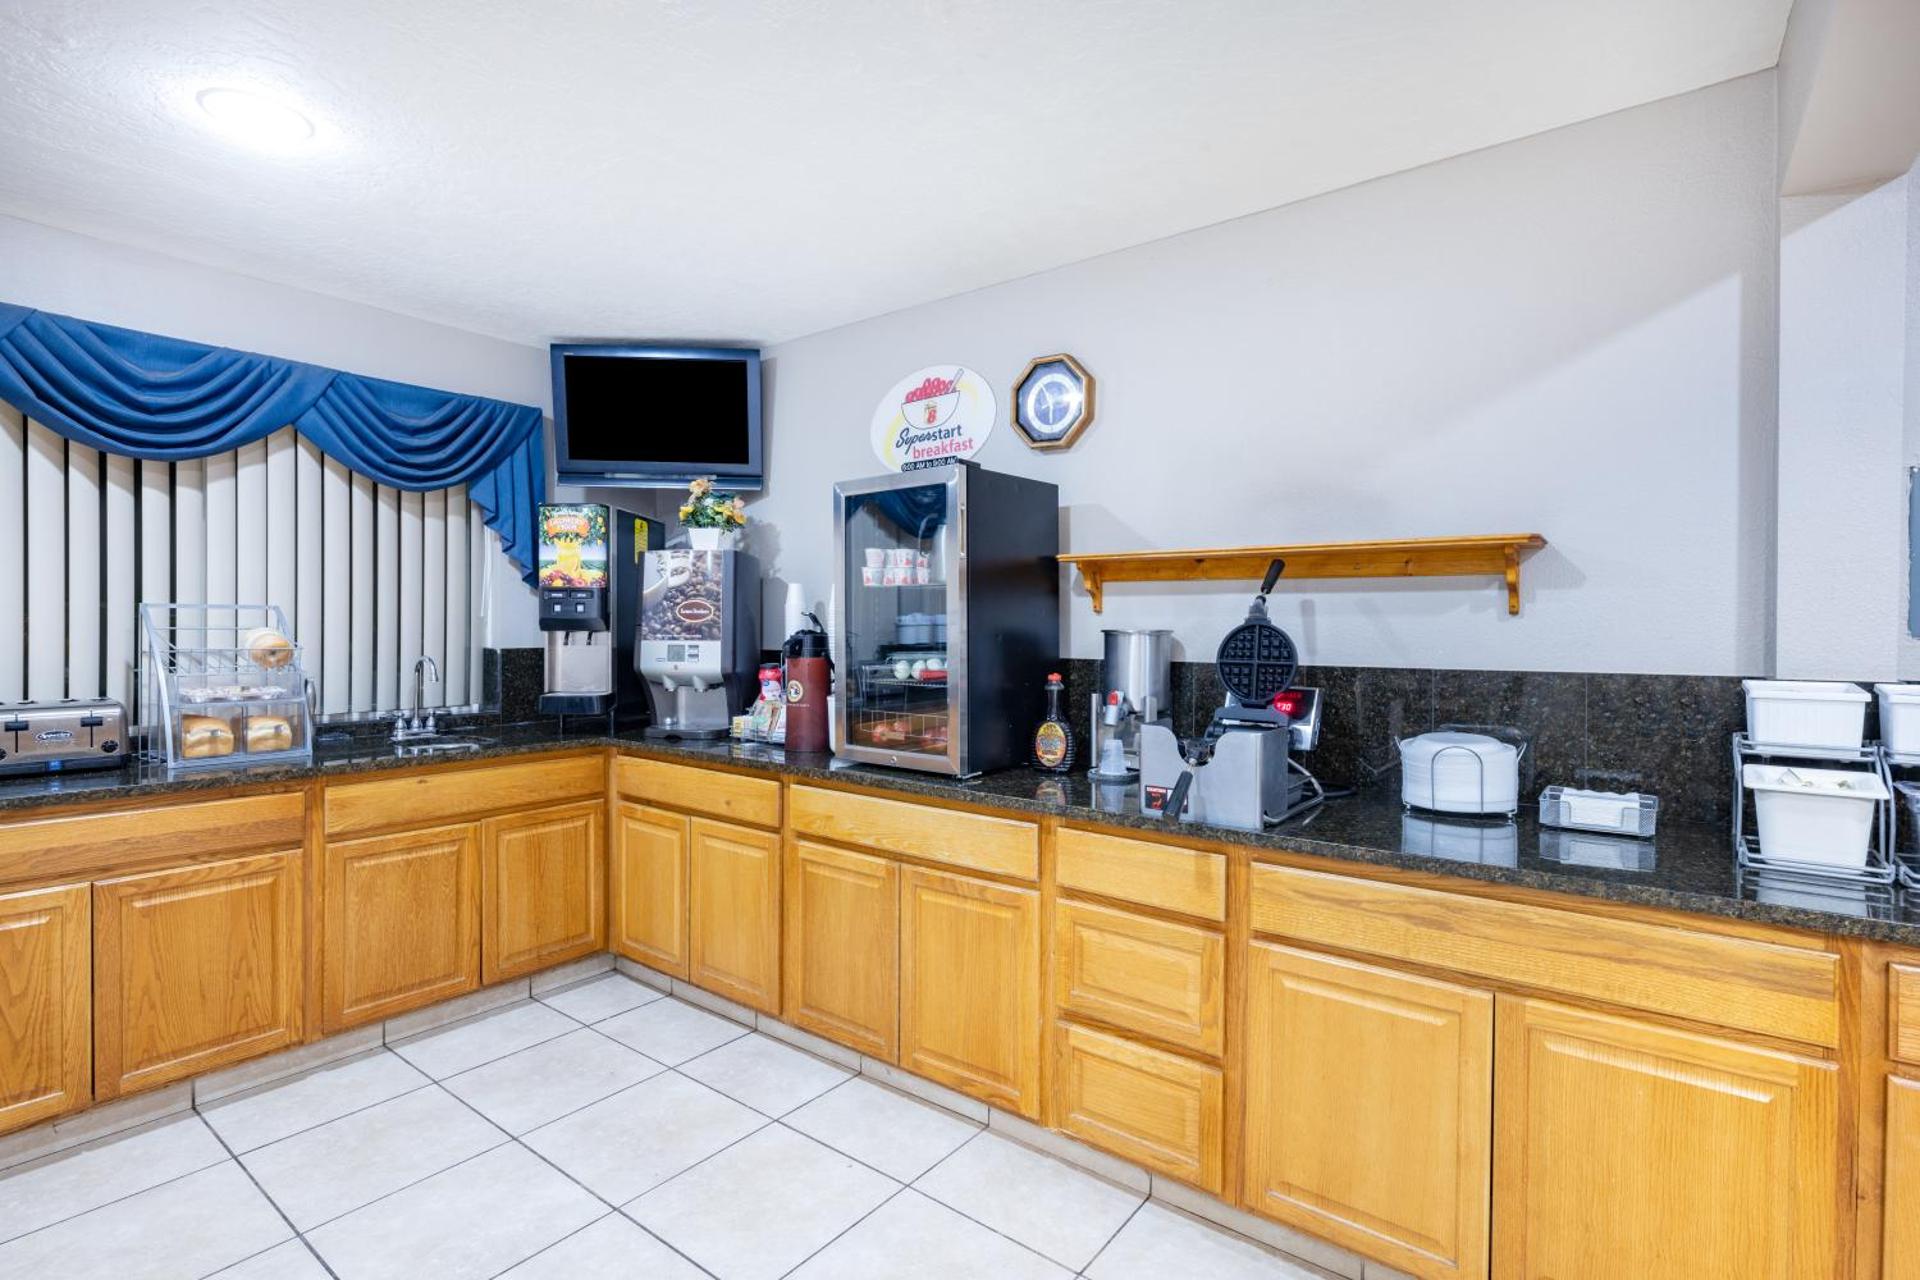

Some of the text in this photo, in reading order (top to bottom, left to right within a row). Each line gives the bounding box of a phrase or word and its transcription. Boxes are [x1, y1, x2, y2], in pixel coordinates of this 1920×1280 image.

[927, 409, 937, 423] 8
[896, 425, 962, 455] Superstart
[913, 438, 974, 459] breakfast
